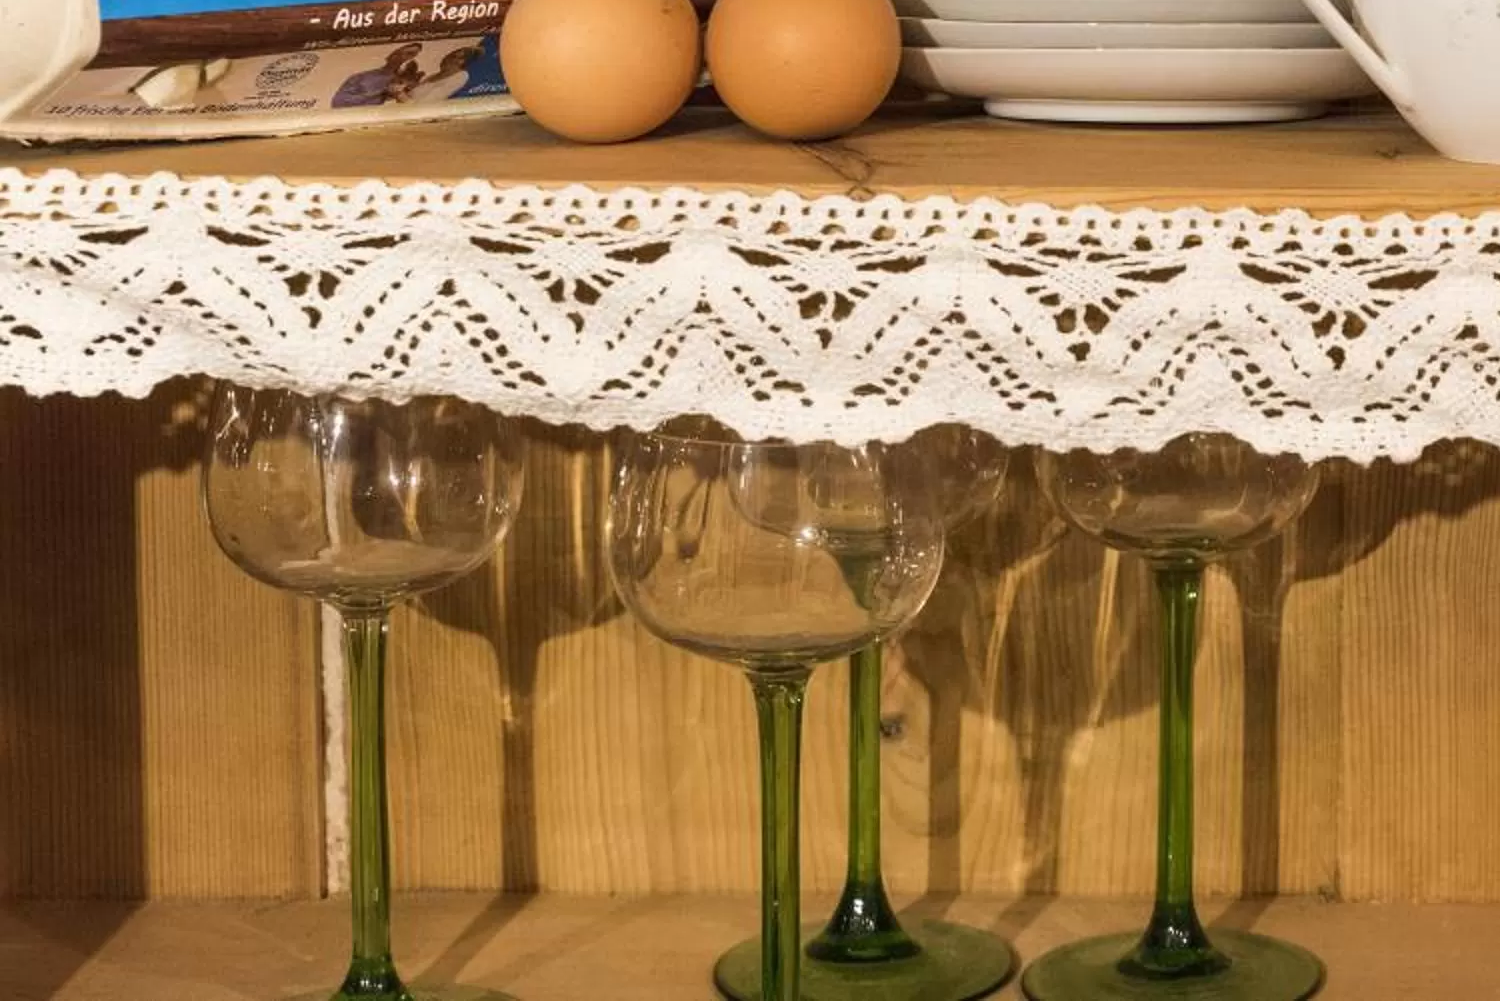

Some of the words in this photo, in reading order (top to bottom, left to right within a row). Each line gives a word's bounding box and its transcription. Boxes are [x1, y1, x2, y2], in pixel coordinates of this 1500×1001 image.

[332, 7, 376, 31] Aus
[384, 2, 422, 26] der
[430, 0, 501, 25] Region
